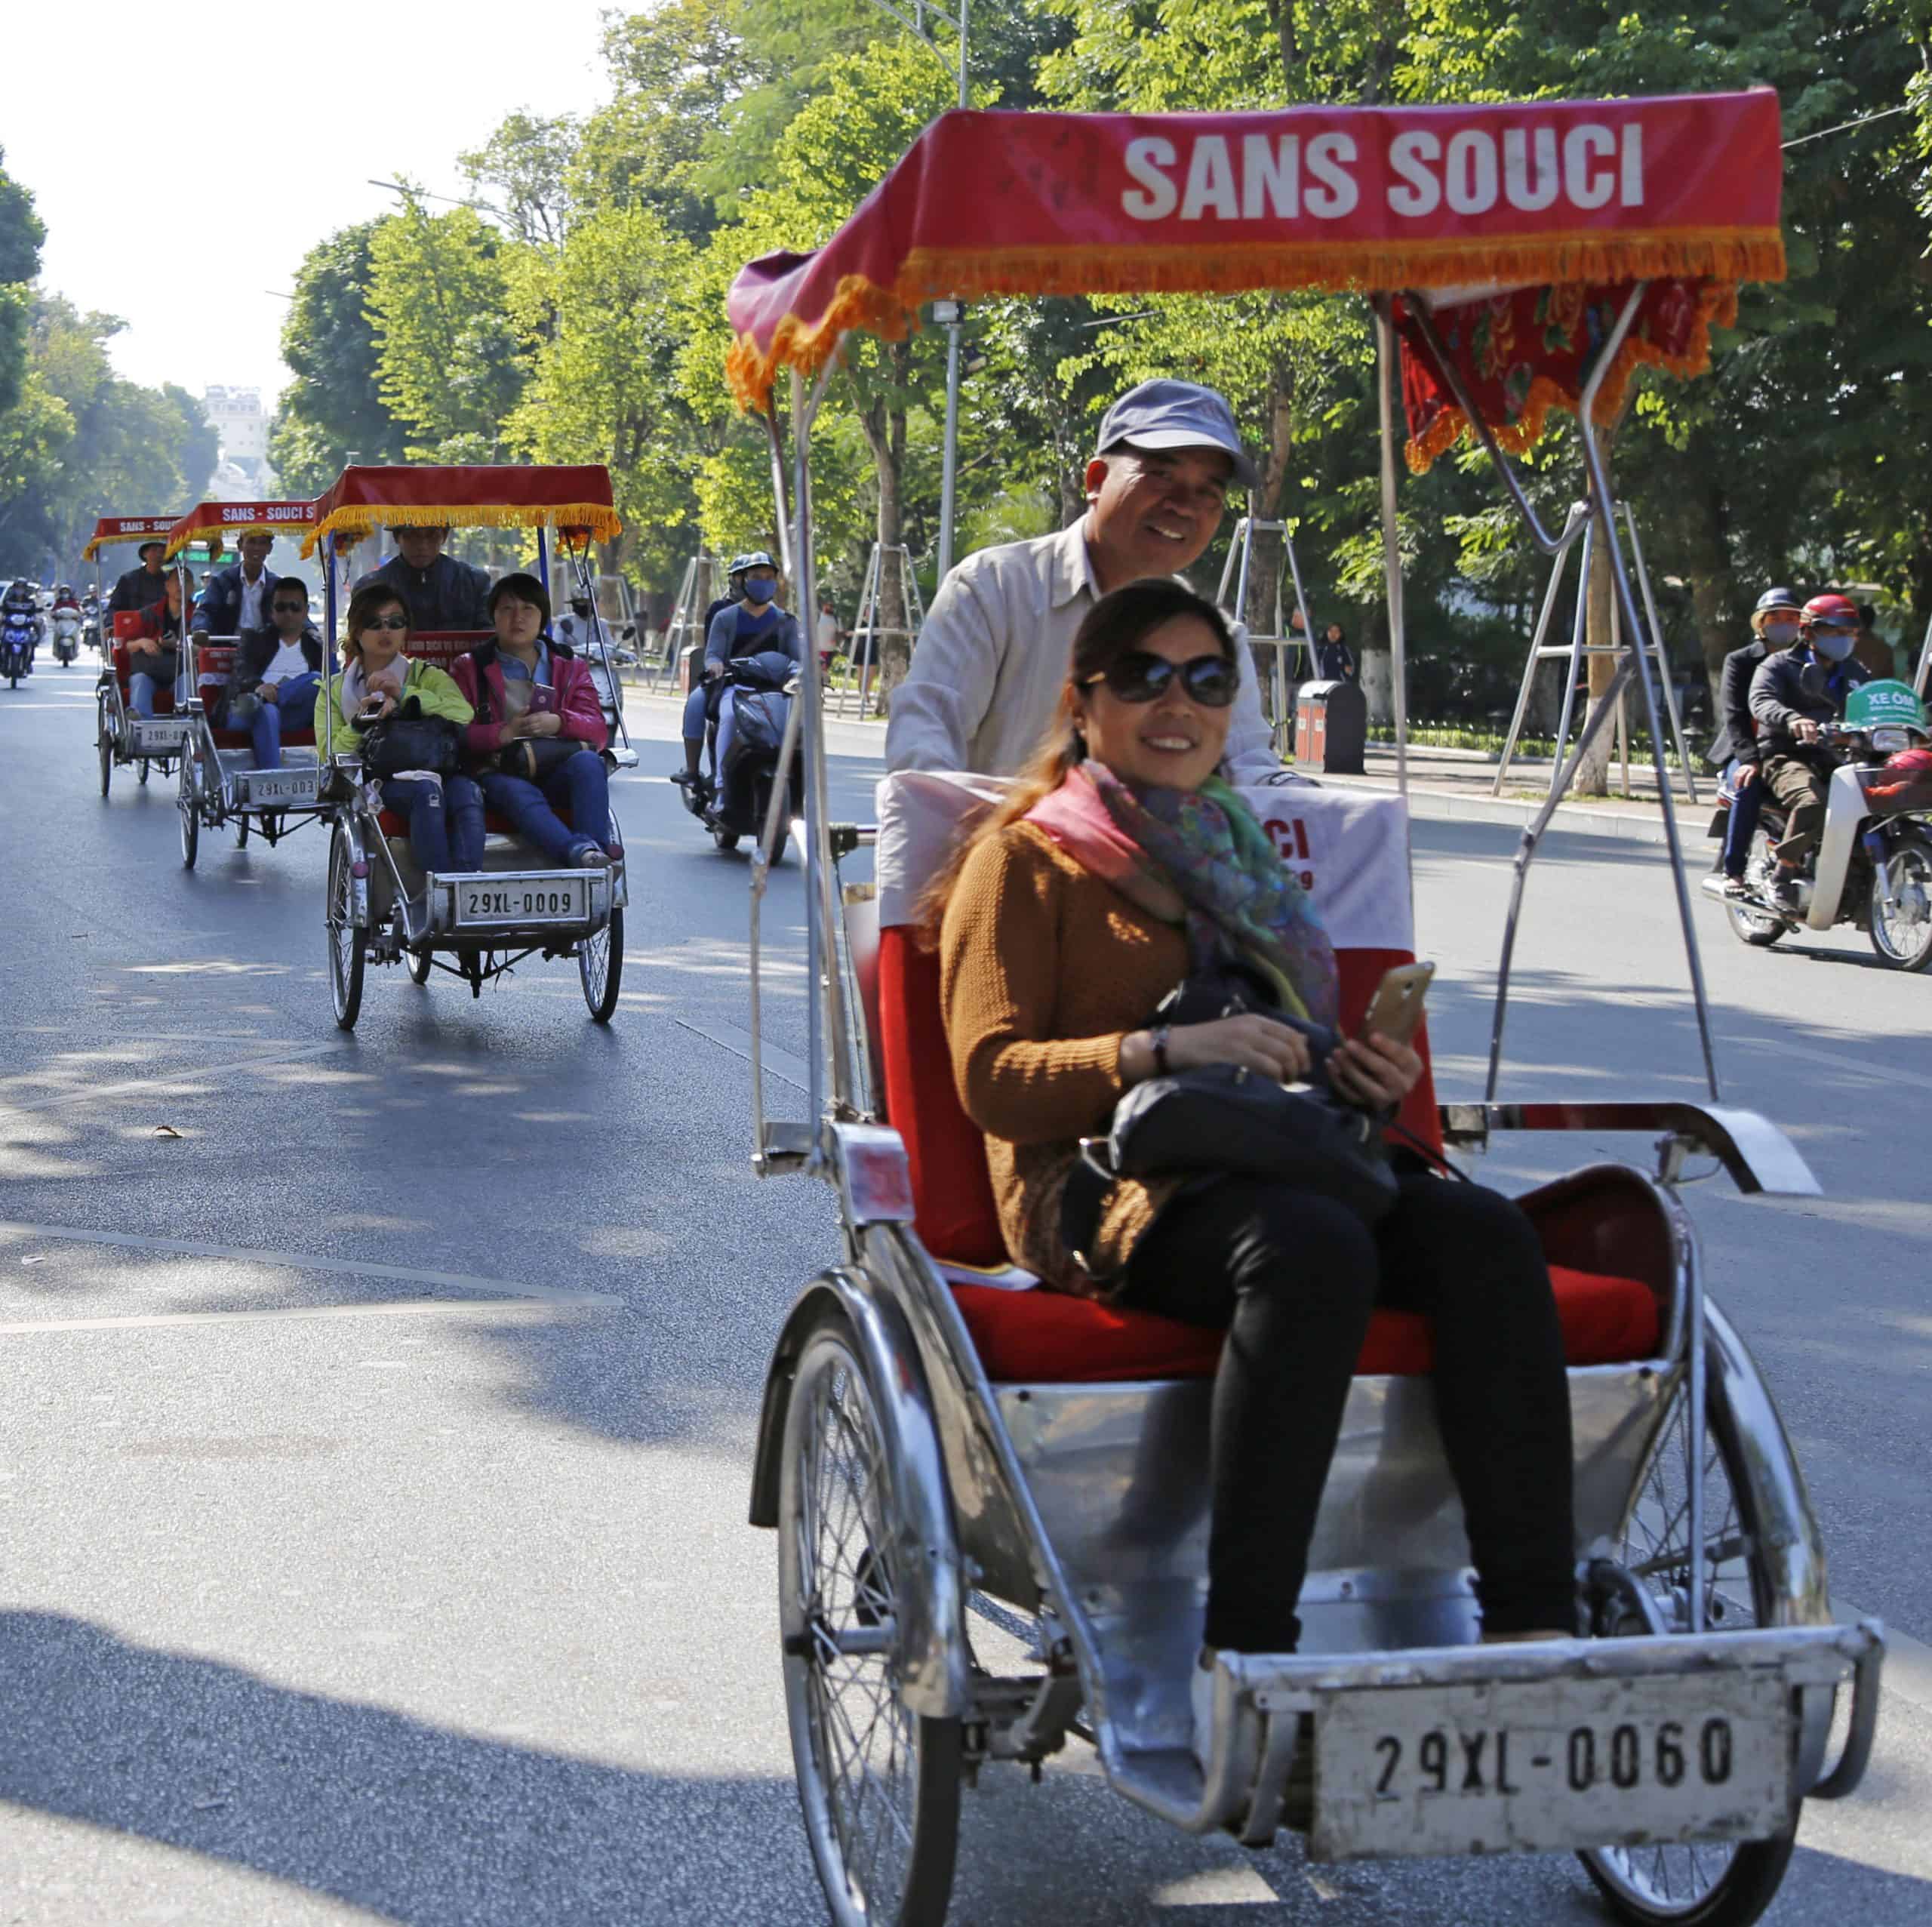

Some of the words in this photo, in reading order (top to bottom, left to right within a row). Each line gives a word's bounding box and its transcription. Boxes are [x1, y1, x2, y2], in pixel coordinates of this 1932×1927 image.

[1121, 132, 1358, 220] SANS
[1387, 124, 1644, 217] SOUCI
[223, 508, 255, 521] SANS
[266, 506, 303, 520] SOUCI
[120, 521, 145, 531] SANS
[1866, 693, 1890, 705] XE
[469, 893, 571, 913] 29XL-0009
[1374, 1717, 1734, 1802] 29XL-0060
